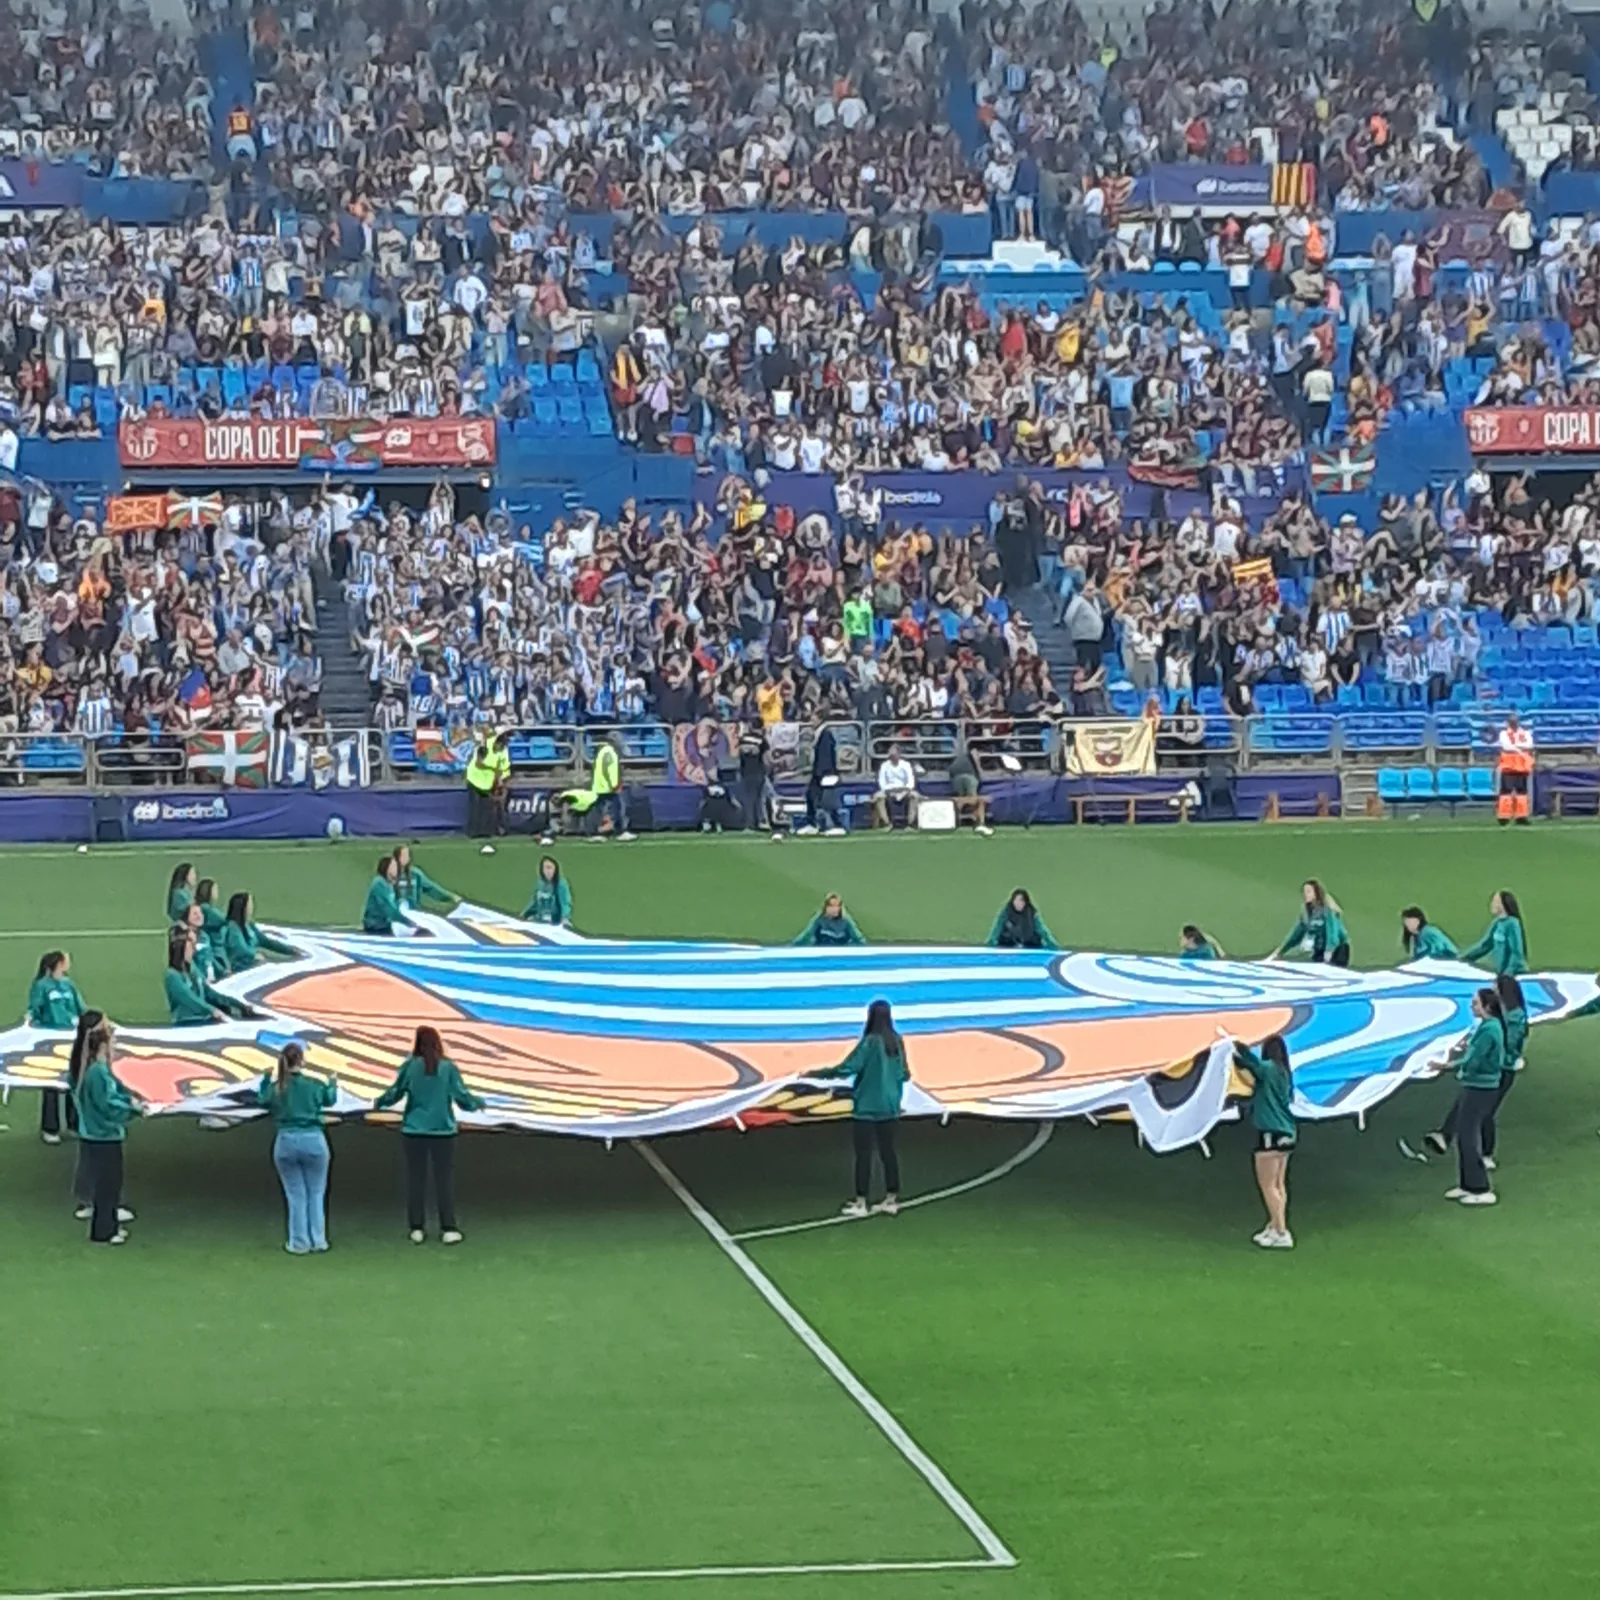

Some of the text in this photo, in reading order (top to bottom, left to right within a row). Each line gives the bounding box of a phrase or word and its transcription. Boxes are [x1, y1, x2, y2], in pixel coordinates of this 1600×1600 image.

[205, 425, 253, 460] COPA
[258, 425, 281, 459] DE
[1544, 411, 1590, 446] COPA
